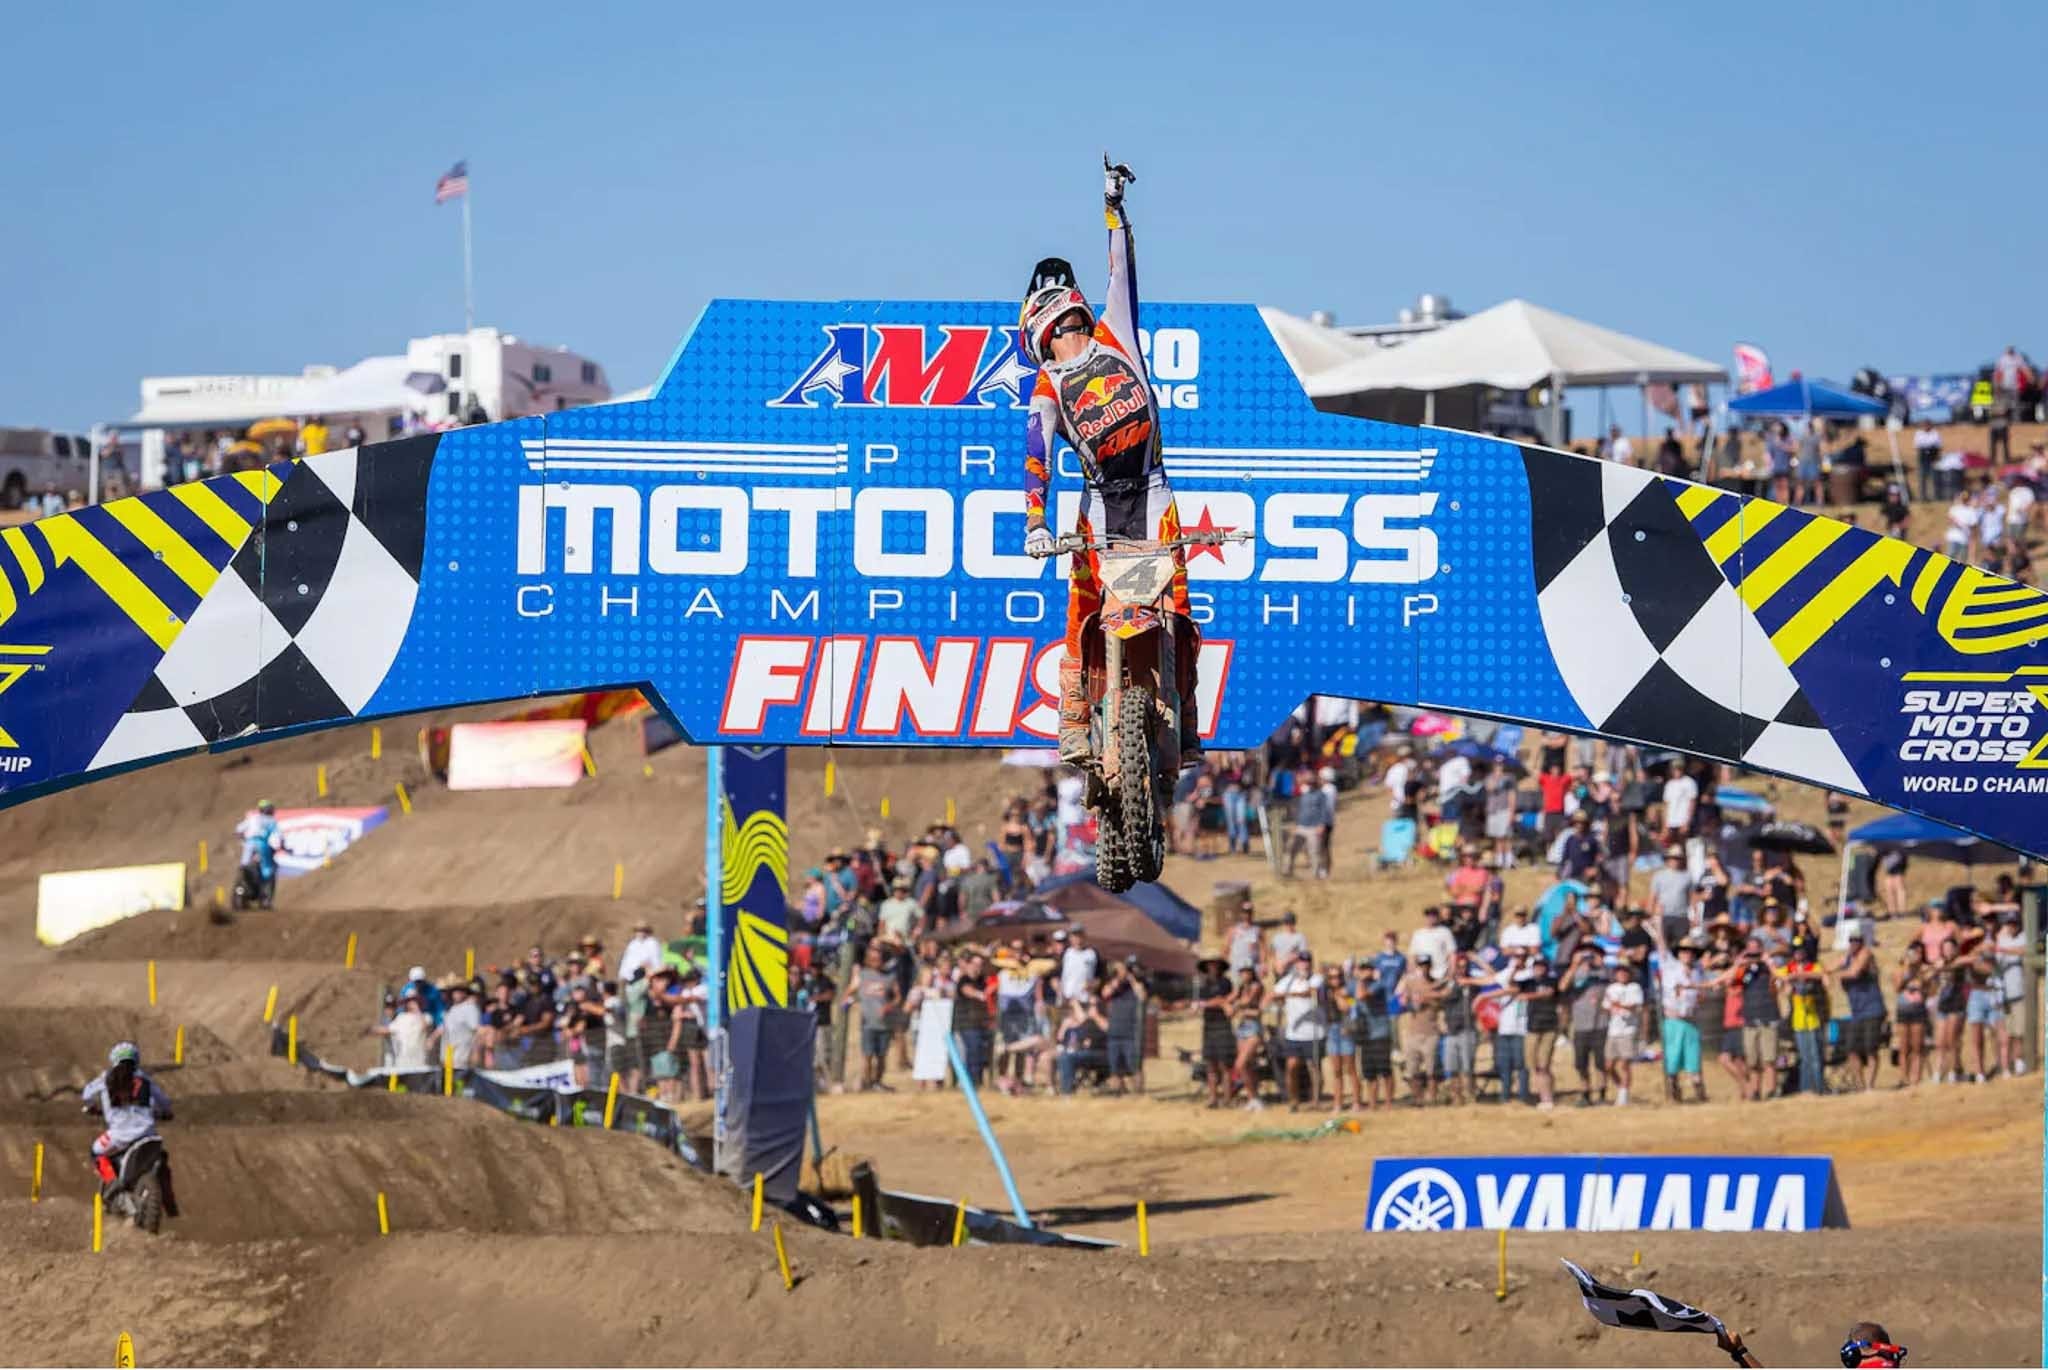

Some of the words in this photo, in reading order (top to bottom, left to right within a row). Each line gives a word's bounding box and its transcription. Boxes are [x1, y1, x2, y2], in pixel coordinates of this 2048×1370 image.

[766, 324, 1040, 408] AMA
[1076, 405, 1117, 441] Red
[1111, 384, 1148, 420] Bull
[1096, 419, 1152, 465] KTM
[1112, 559, 1157, 595] 4
[517, 585, 1439, 628] CHAMPIOSHIP
[1900, 690, 2037, 713] SUPER
[1908, 715, 2030, 738] MOTO
[1900, 739, 2032, 762] CROSS
[1903, 776, 1978, 792] WORLD
[1982, 776, 2048, 793] CHAM
[1475, 1174, 1806, 1232] YAMAHA
